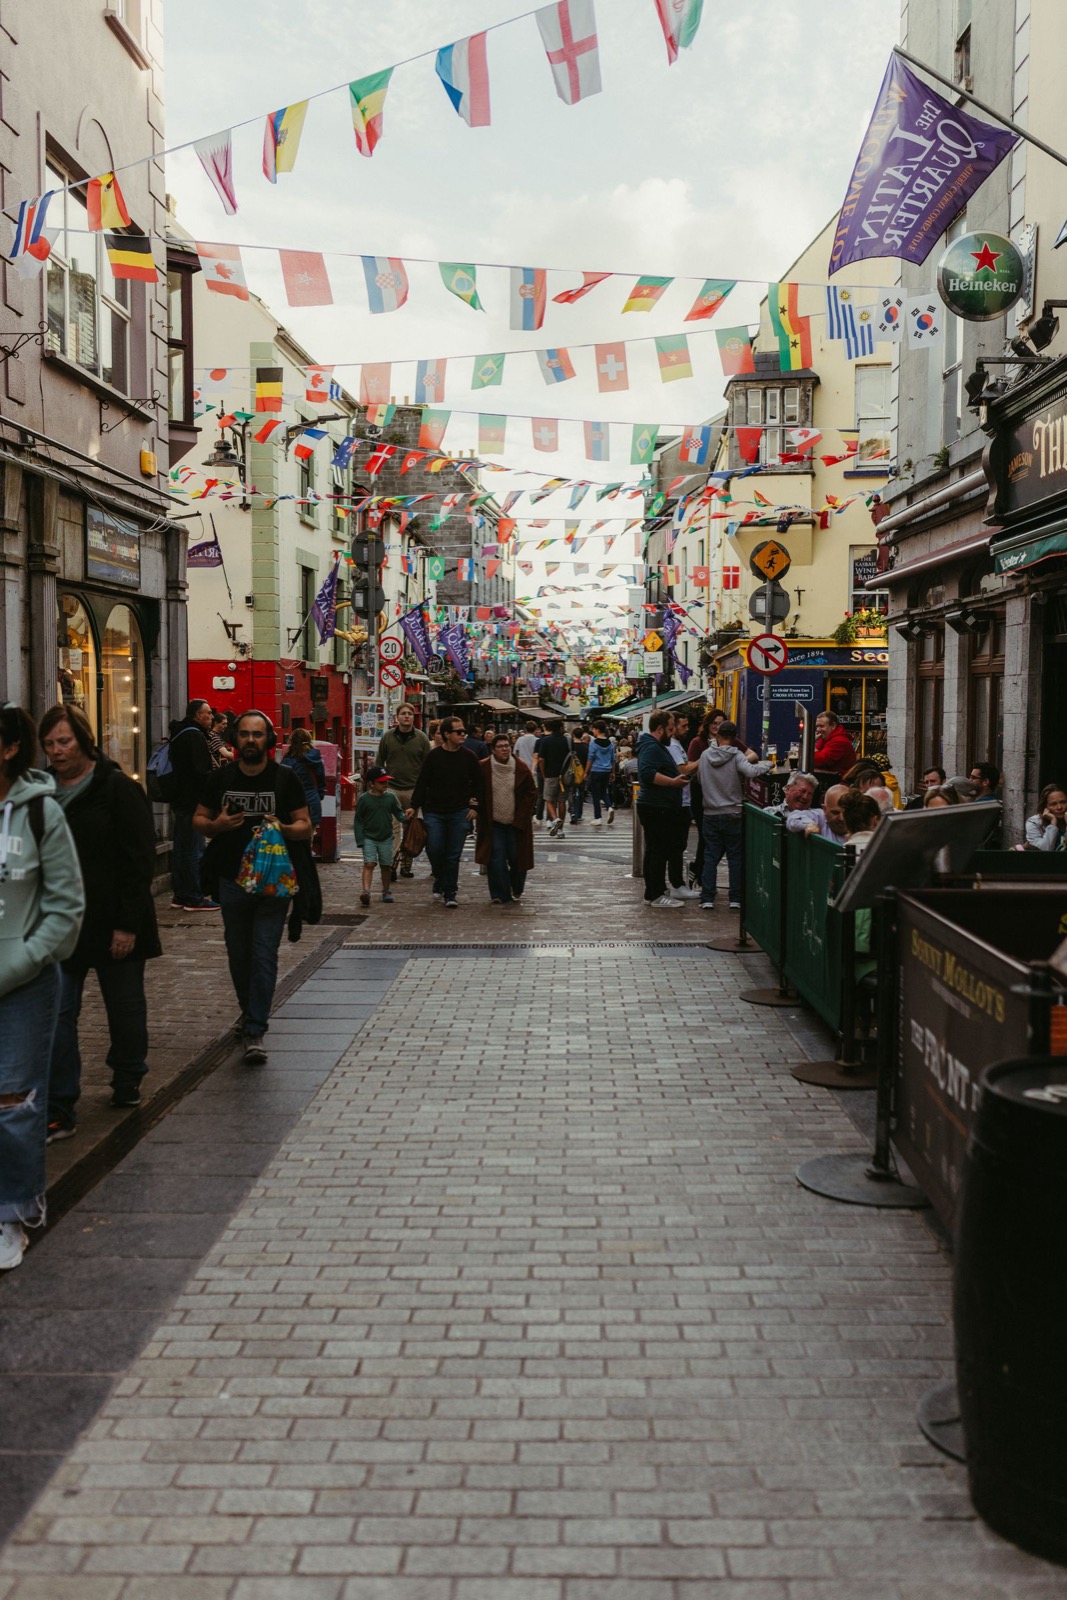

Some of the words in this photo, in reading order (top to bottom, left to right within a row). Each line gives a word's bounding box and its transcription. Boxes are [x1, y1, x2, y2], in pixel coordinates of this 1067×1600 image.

[948, 278, 1017, 293] Heineken
[1008, 451, 1033, 478] JAMESON
[384, 642, 397, 654] 20
[807, 650, 824, 658] 1894
[911, 928, 942, 975] SONNY
